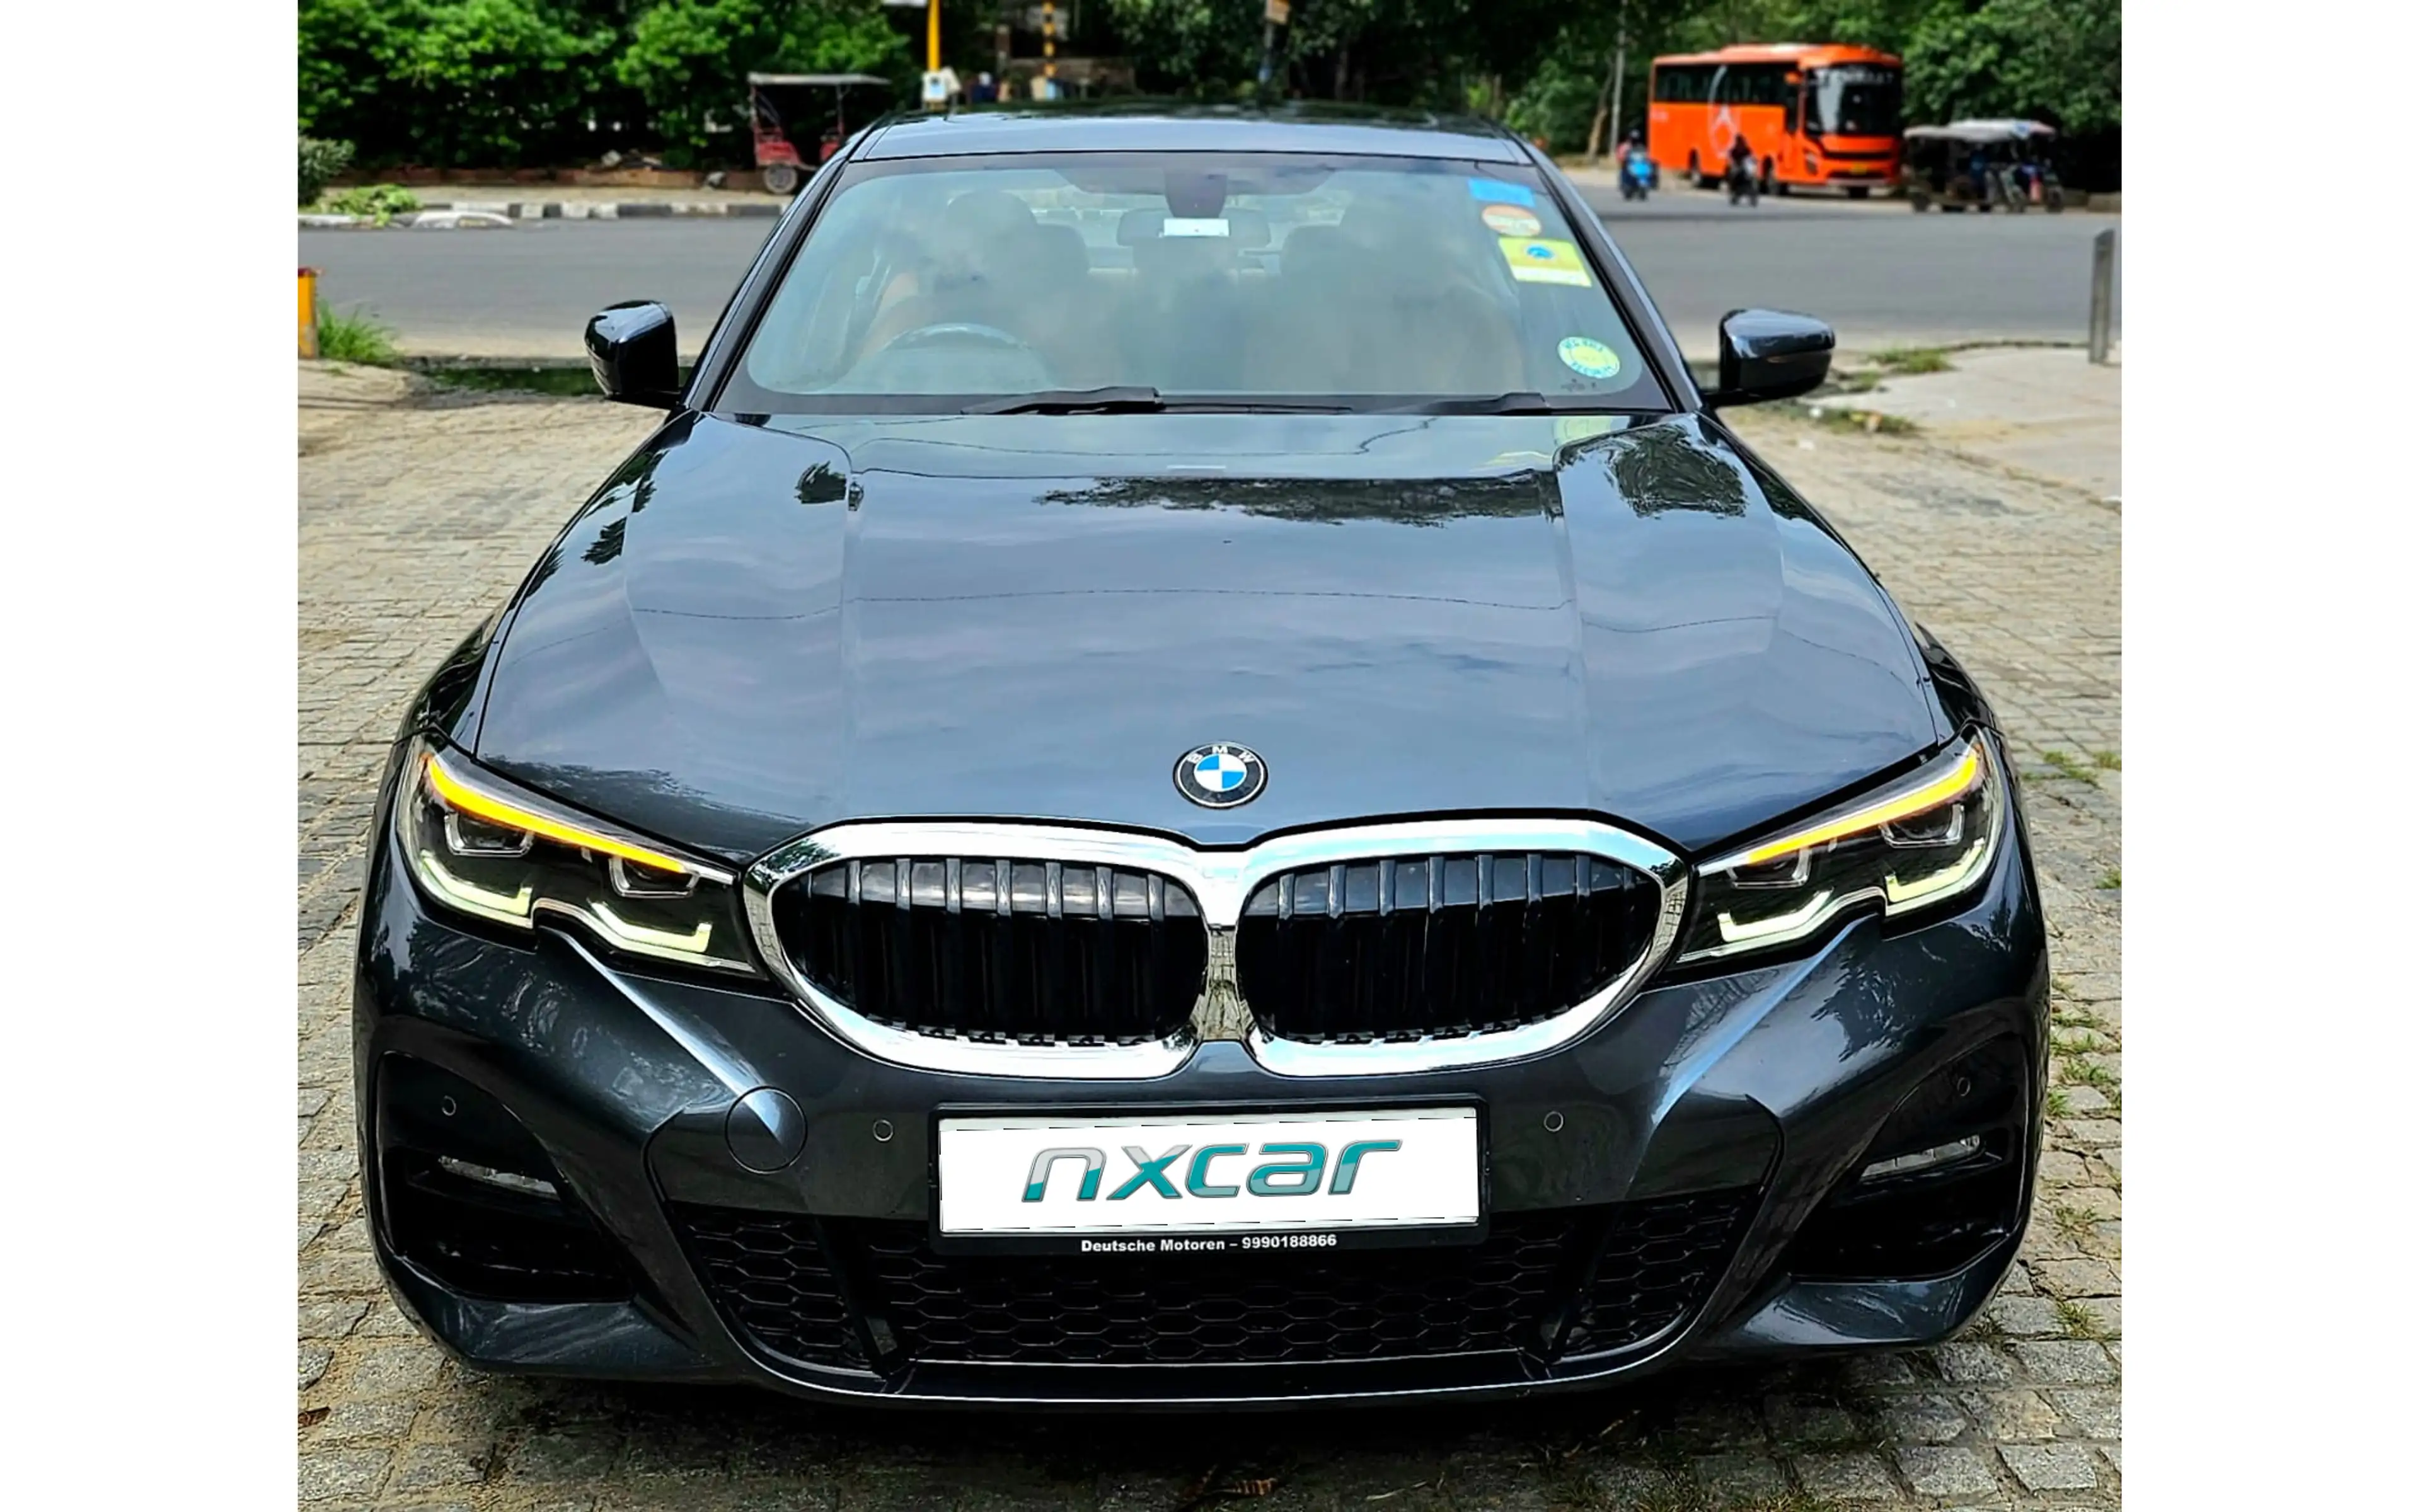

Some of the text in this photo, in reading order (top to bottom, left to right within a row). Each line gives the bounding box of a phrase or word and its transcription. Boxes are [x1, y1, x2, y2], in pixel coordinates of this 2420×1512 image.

[1187, 745, 1255, 764] BMW
[1081, 1239, 1156, 1252] Deutsche
[1161, 1239, 1225, 1251] Motoren
[1242, 1234, 1337, 1249] 9990188866
